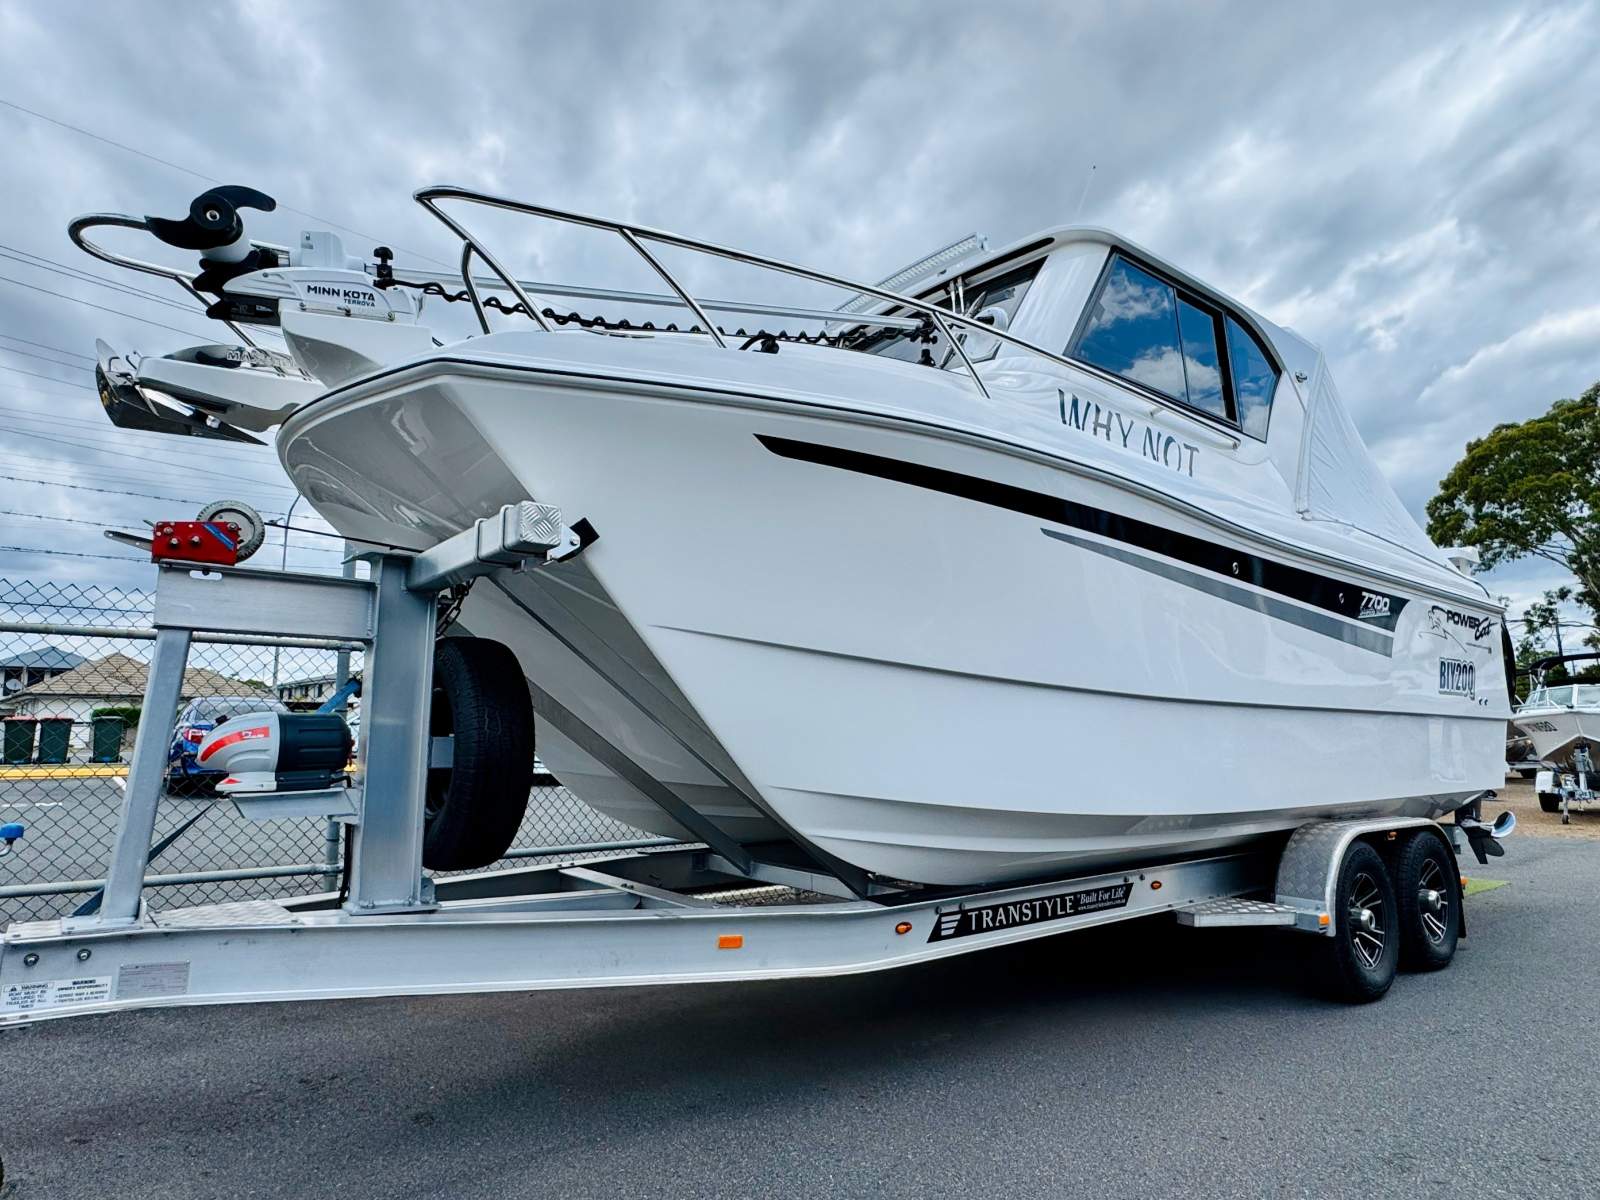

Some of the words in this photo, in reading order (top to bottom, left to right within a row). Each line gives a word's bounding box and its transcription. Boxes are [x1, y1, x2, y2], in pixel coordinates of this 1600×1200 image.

[307, 285, 340, 297] MINN
[343, 289, 375, 301] KOTA
[344, 299, 375, 307] TERROVA
[1058, 388, 1134, 448] WHY
[1143, 426, 1199, 478] NOT
[1361, 591, 1390, 611] 7700
[1447, 610, 1480, 629] POWER
[968, 896, 1074, 931] TRANSTYLE
[1098, 890, 1110, 901] For
